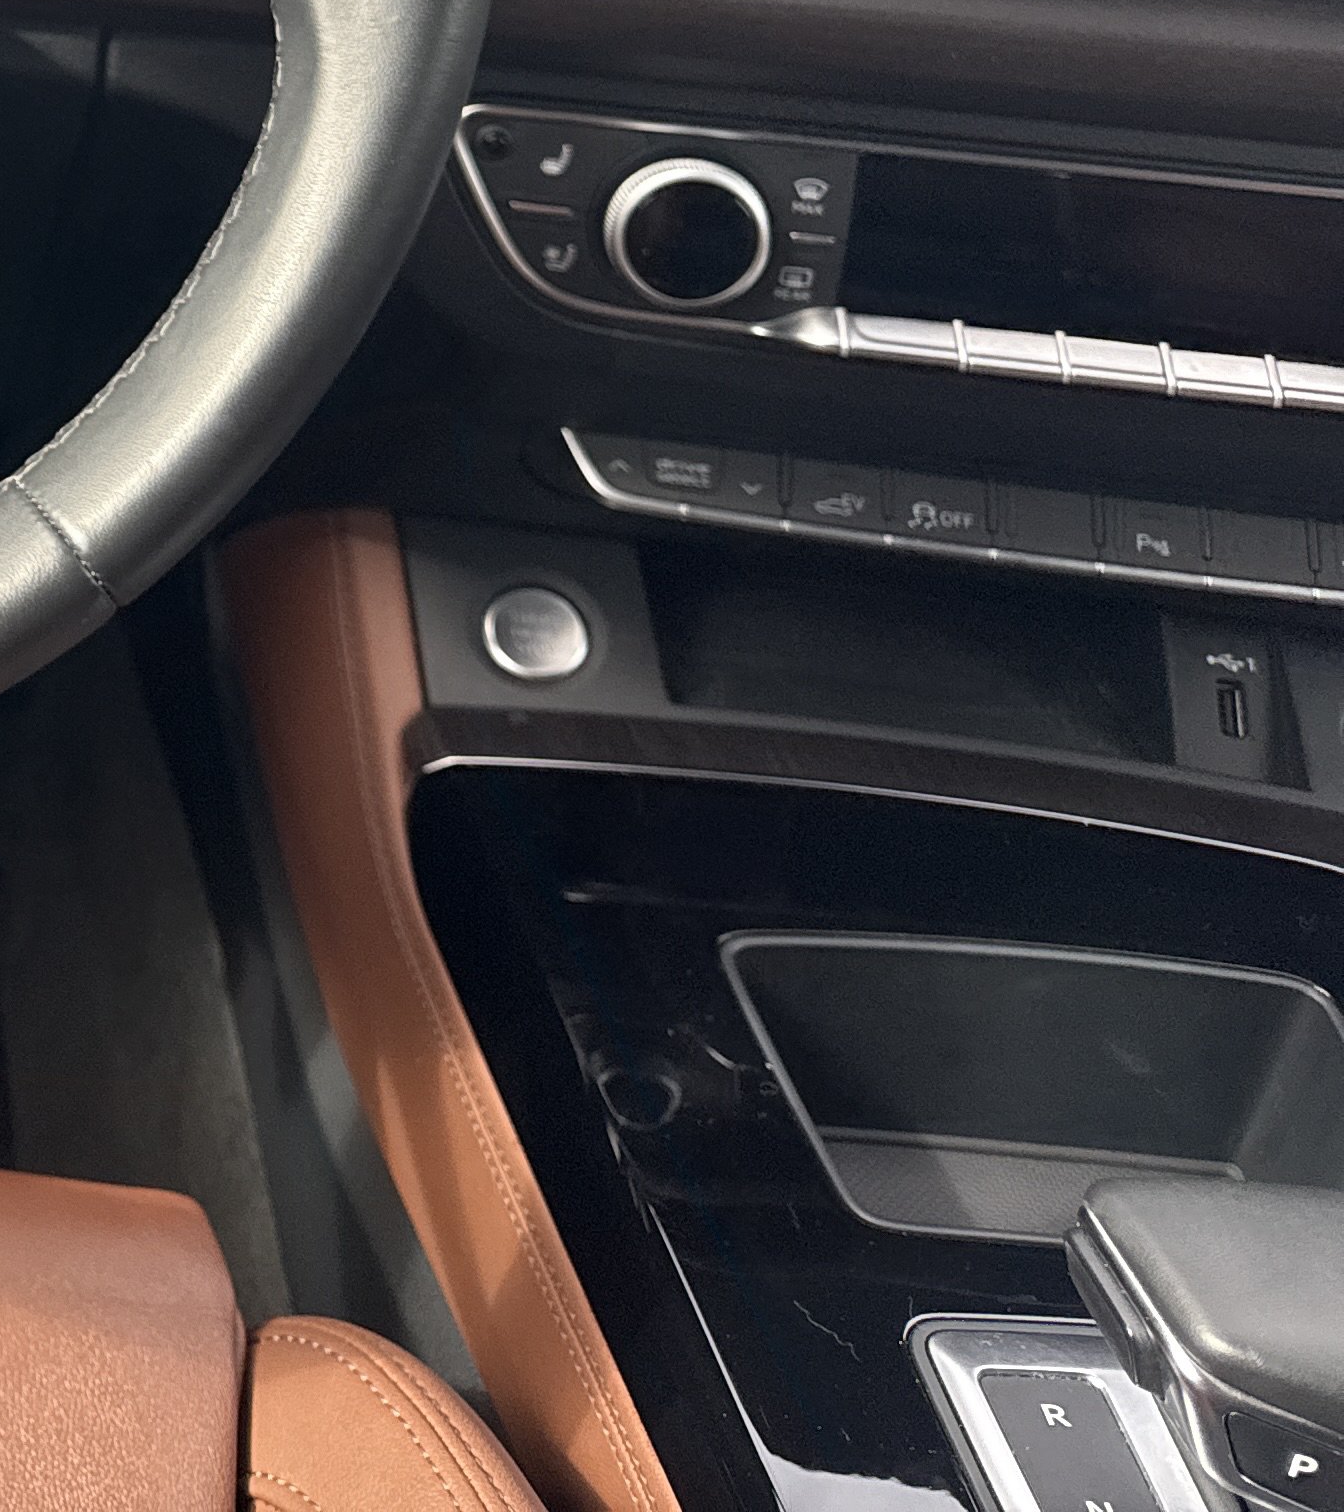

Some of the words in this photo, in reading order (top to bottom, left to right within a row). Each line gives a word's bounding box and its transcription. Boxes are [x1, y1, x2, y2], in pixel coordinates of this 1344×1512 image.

[939, 509, 974, 529] OFF
[1040, 1403, 1072, 1428] R
[1288, 1452, 1320, 1479] P
